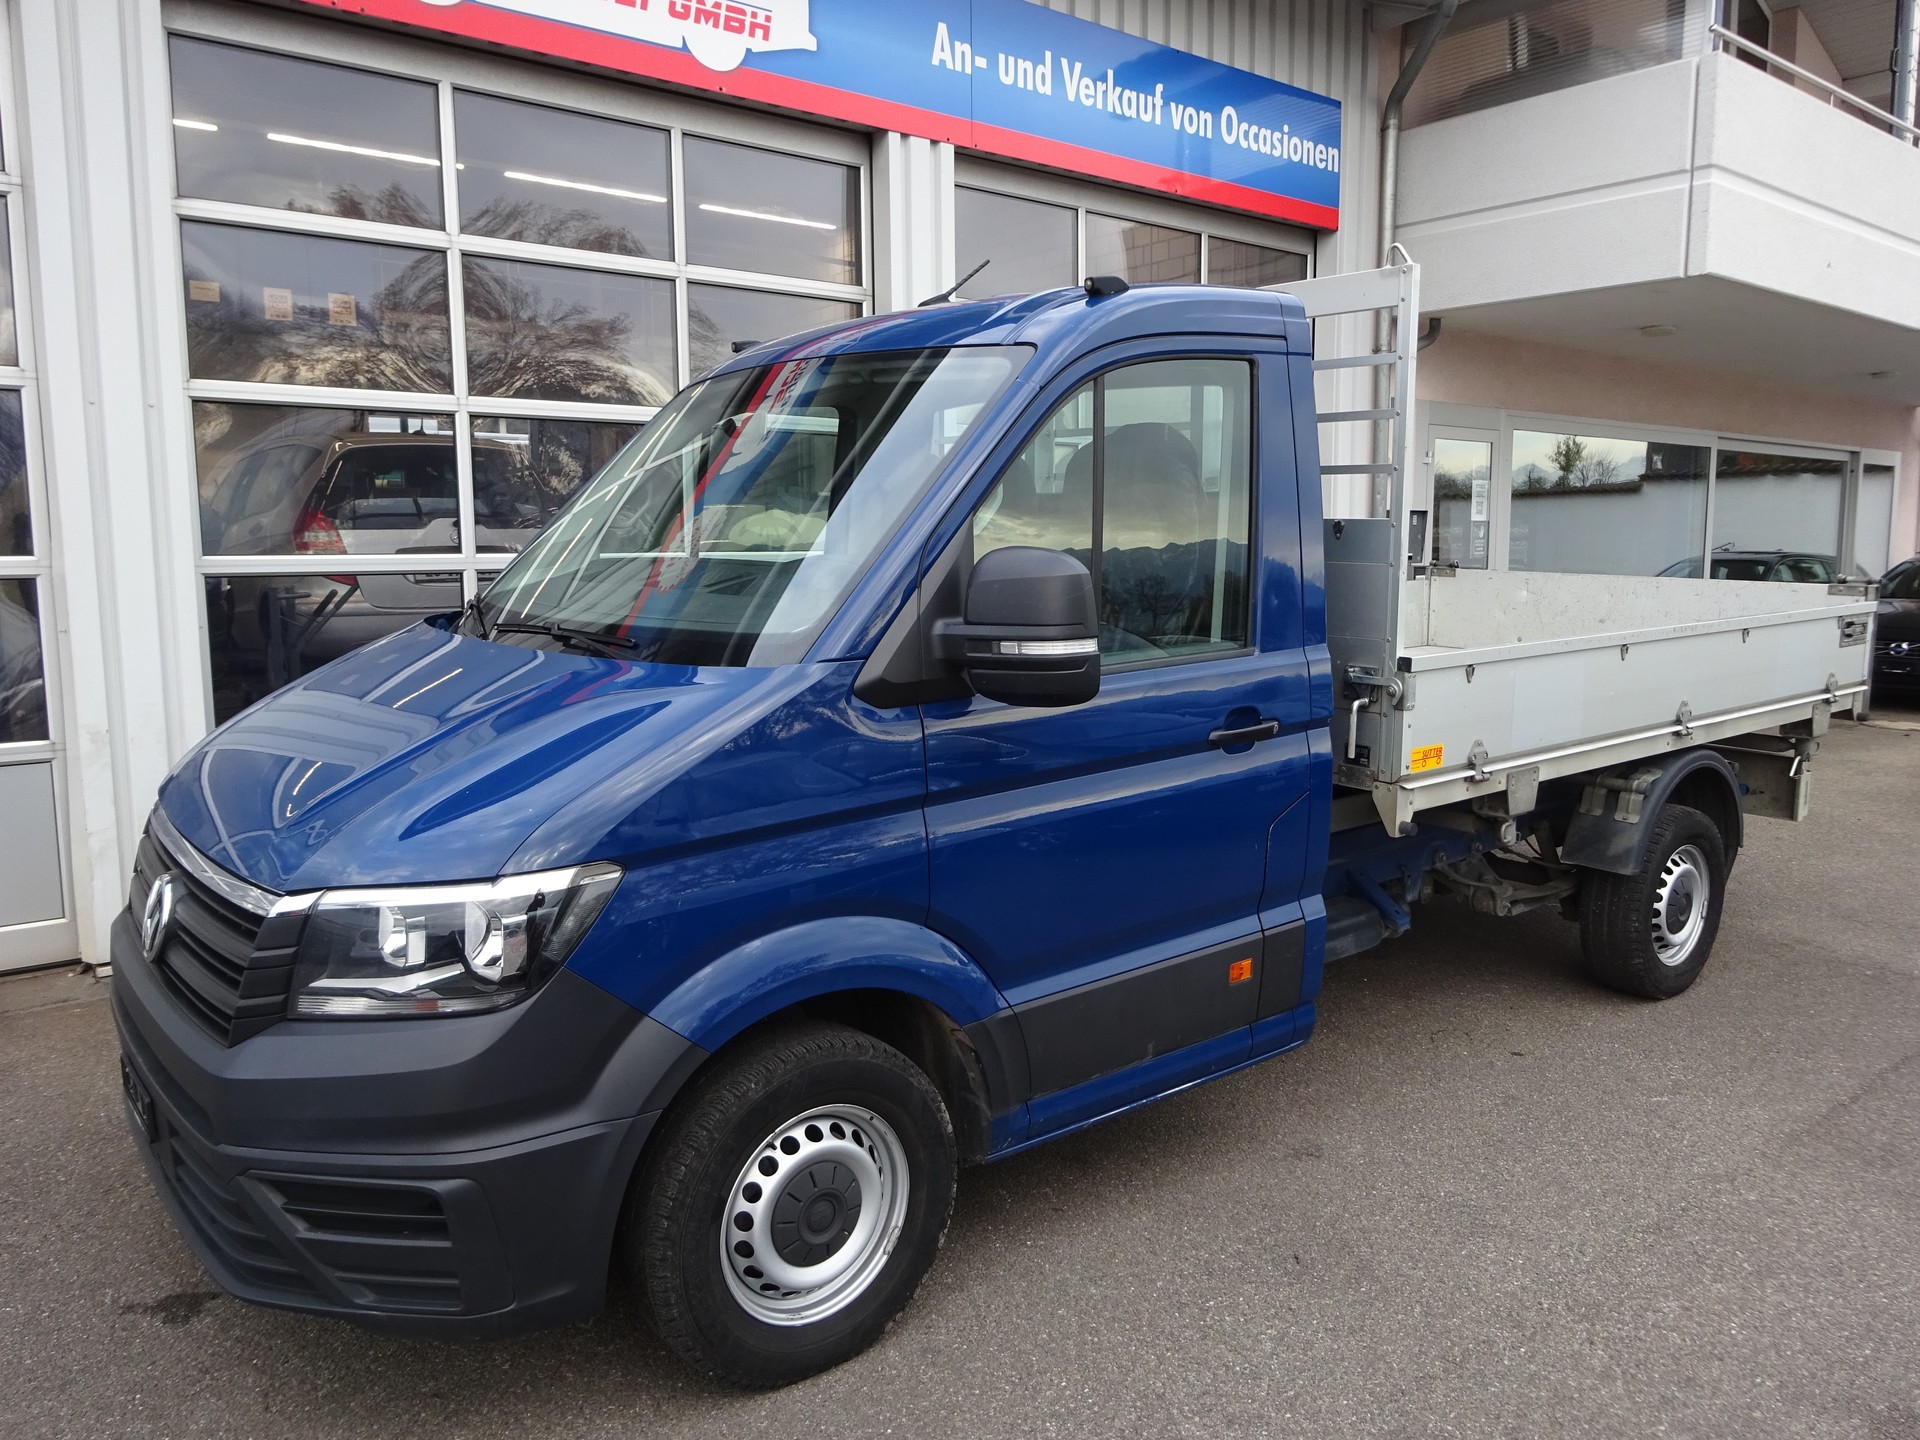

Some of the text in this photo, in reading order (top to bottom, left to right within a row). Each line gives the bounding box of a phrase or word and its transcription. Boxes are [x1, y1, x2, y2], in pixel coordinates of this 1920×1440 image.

[931, 21, 1340, 173] An- und Verkauf von Occasionen
